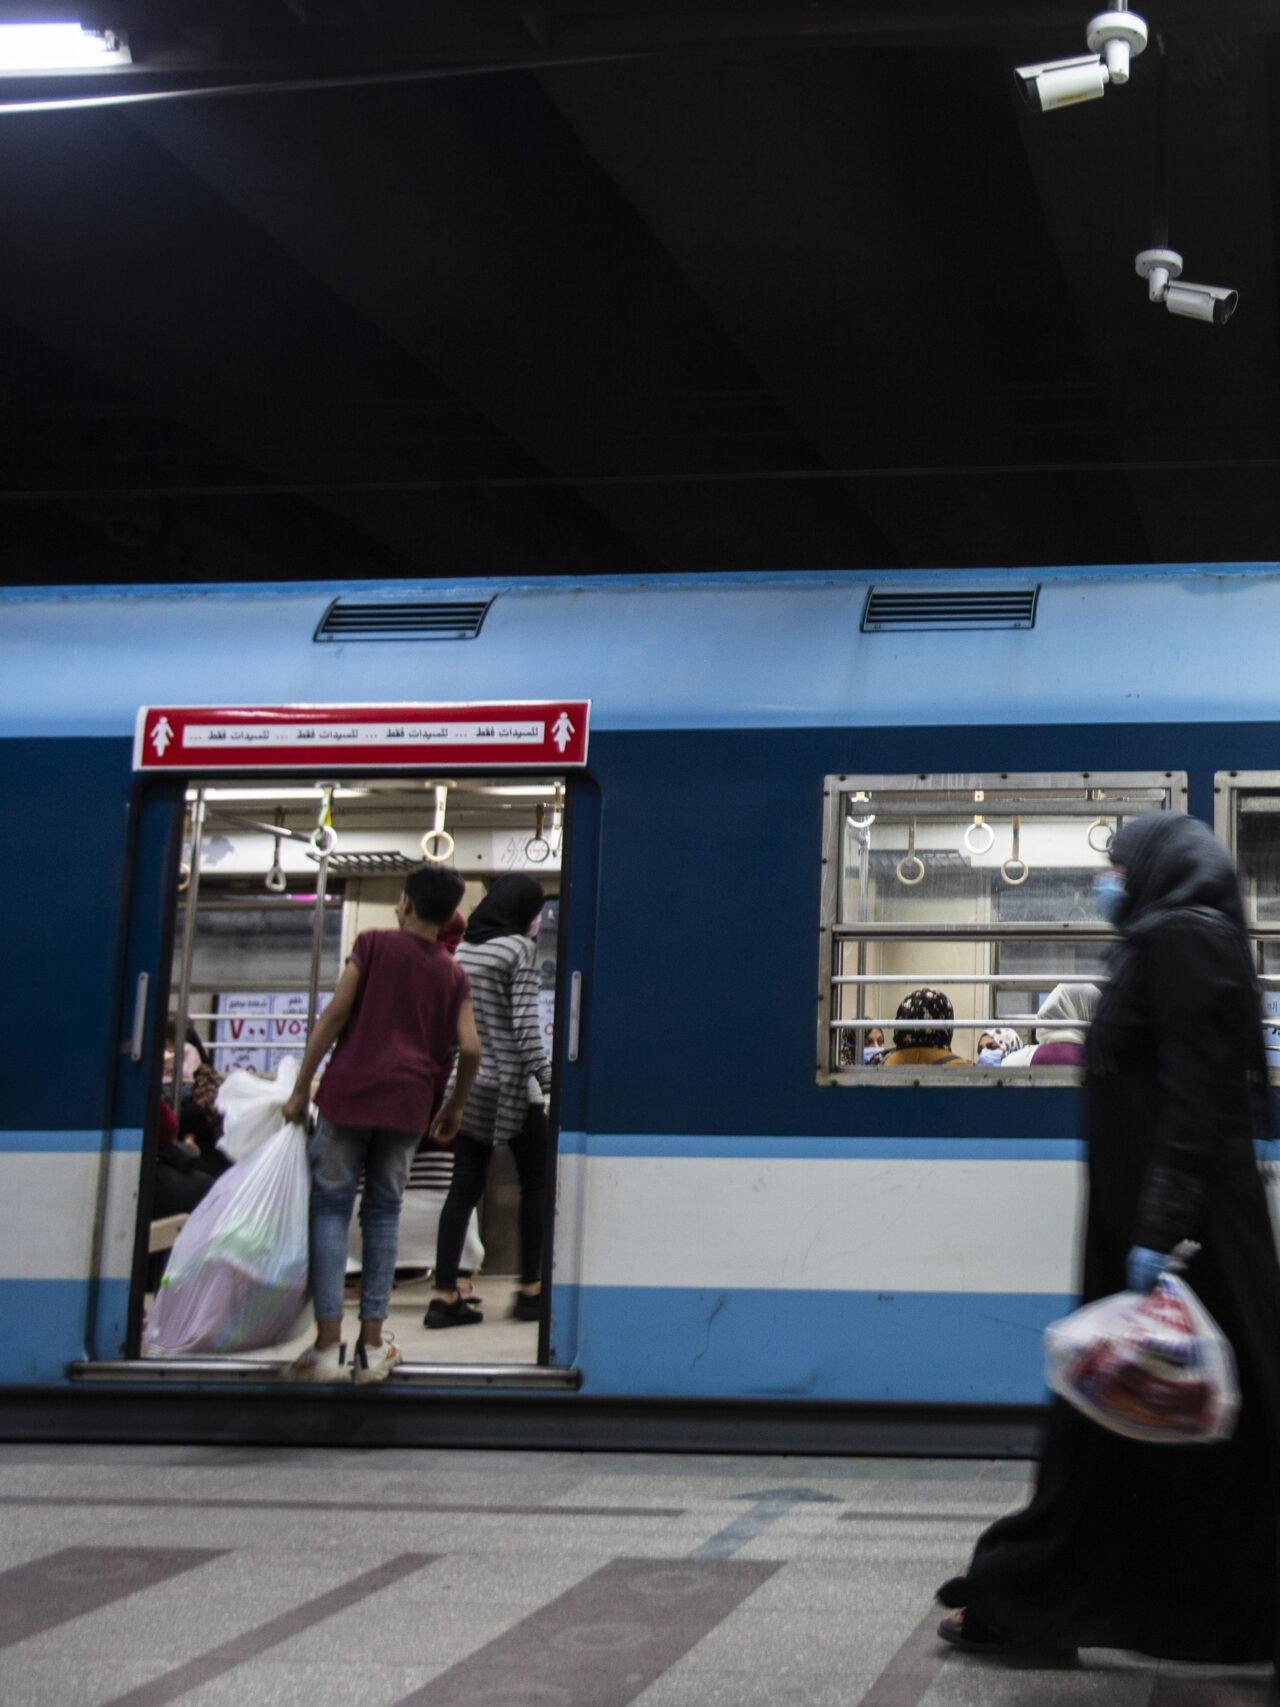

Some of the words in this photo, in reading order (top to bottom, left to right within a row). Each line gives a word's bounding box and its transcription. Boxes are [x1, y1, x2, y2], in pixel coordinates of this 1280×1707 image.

[208, 728, 226, 740] فقط
[231, 730, 270, 742] للسيدات
[296, 728, 315, 739] فقط
[319, 729, 358, 741] للسيدات
[386, 726, 405, 738] فقط
[408, 728, 448, 740] للسيدات
[476, 725, 495, 737] فقط
[499, 727, 538, 739] للسيدات
